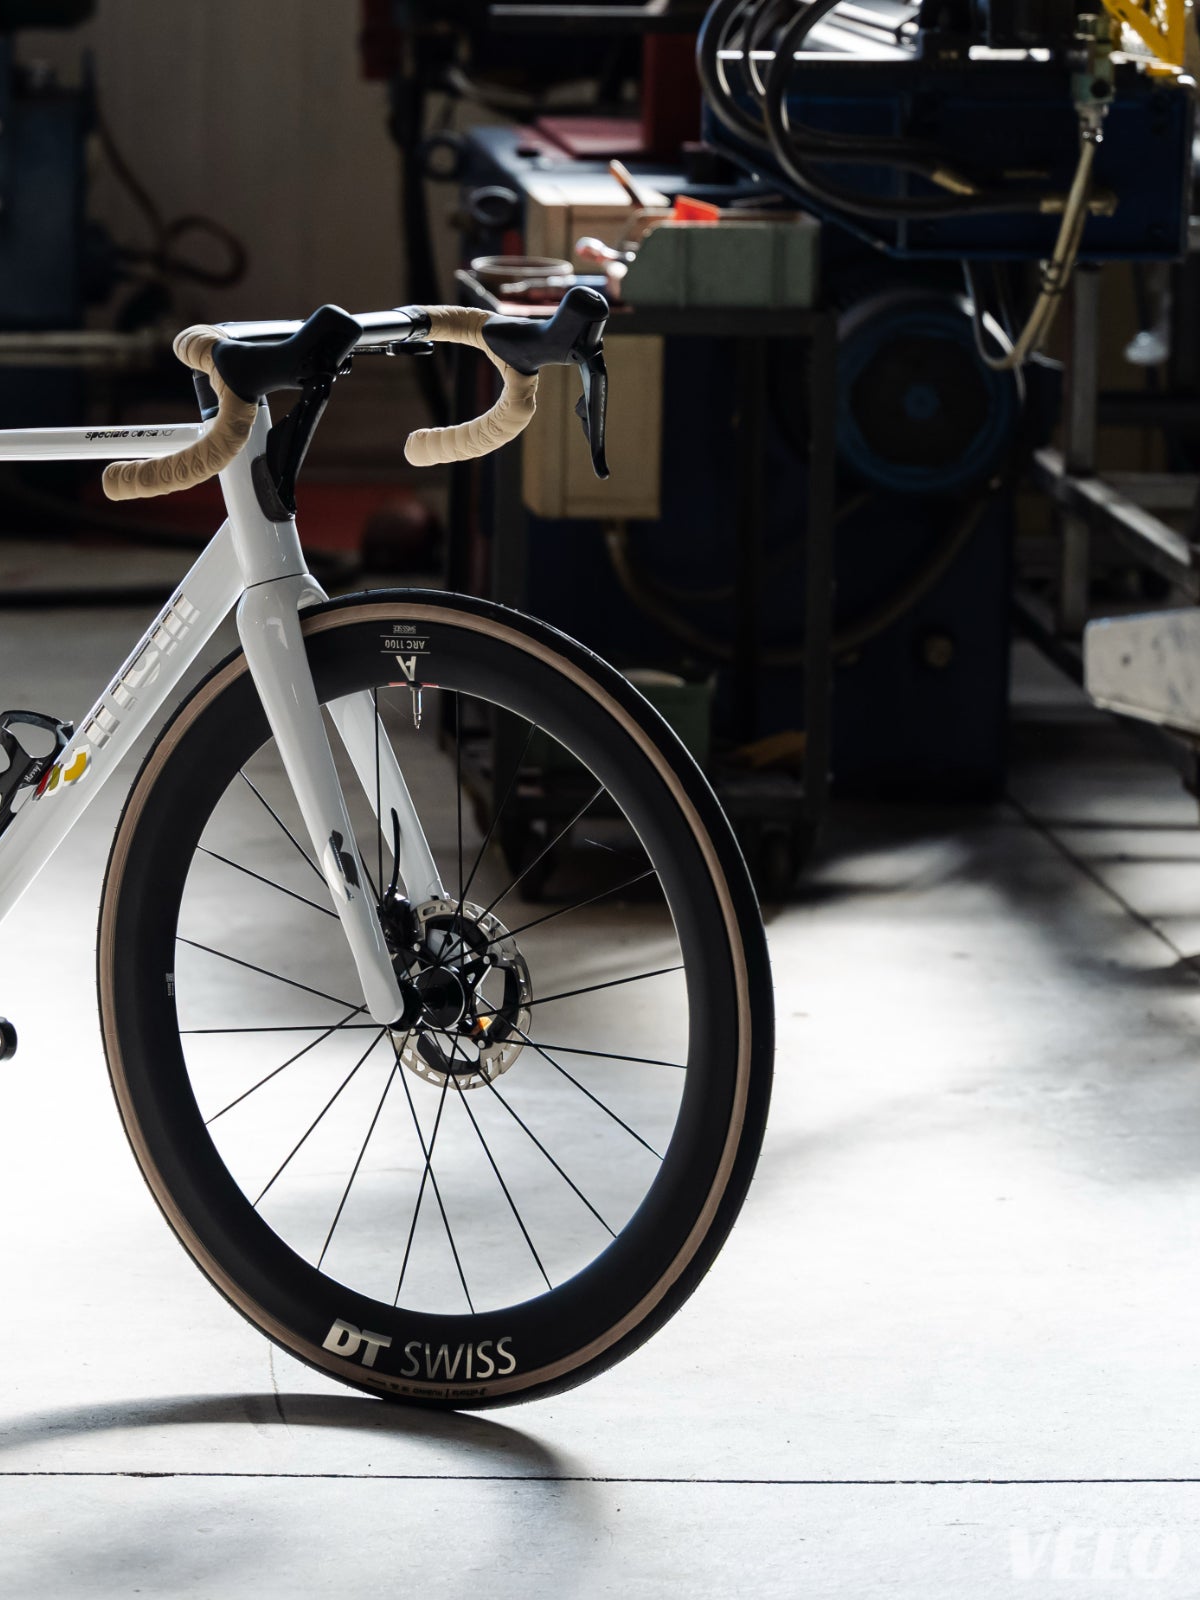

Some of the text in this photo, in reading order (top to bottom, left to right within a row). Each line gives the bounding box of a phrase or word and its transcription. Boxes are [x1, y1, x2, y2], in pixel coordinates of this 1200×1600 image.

[131, 429, 158, 438] corsa
[384, 639, 426, 650] ARC 1100
[322, 1318, 517, 1380] DT SWISS
